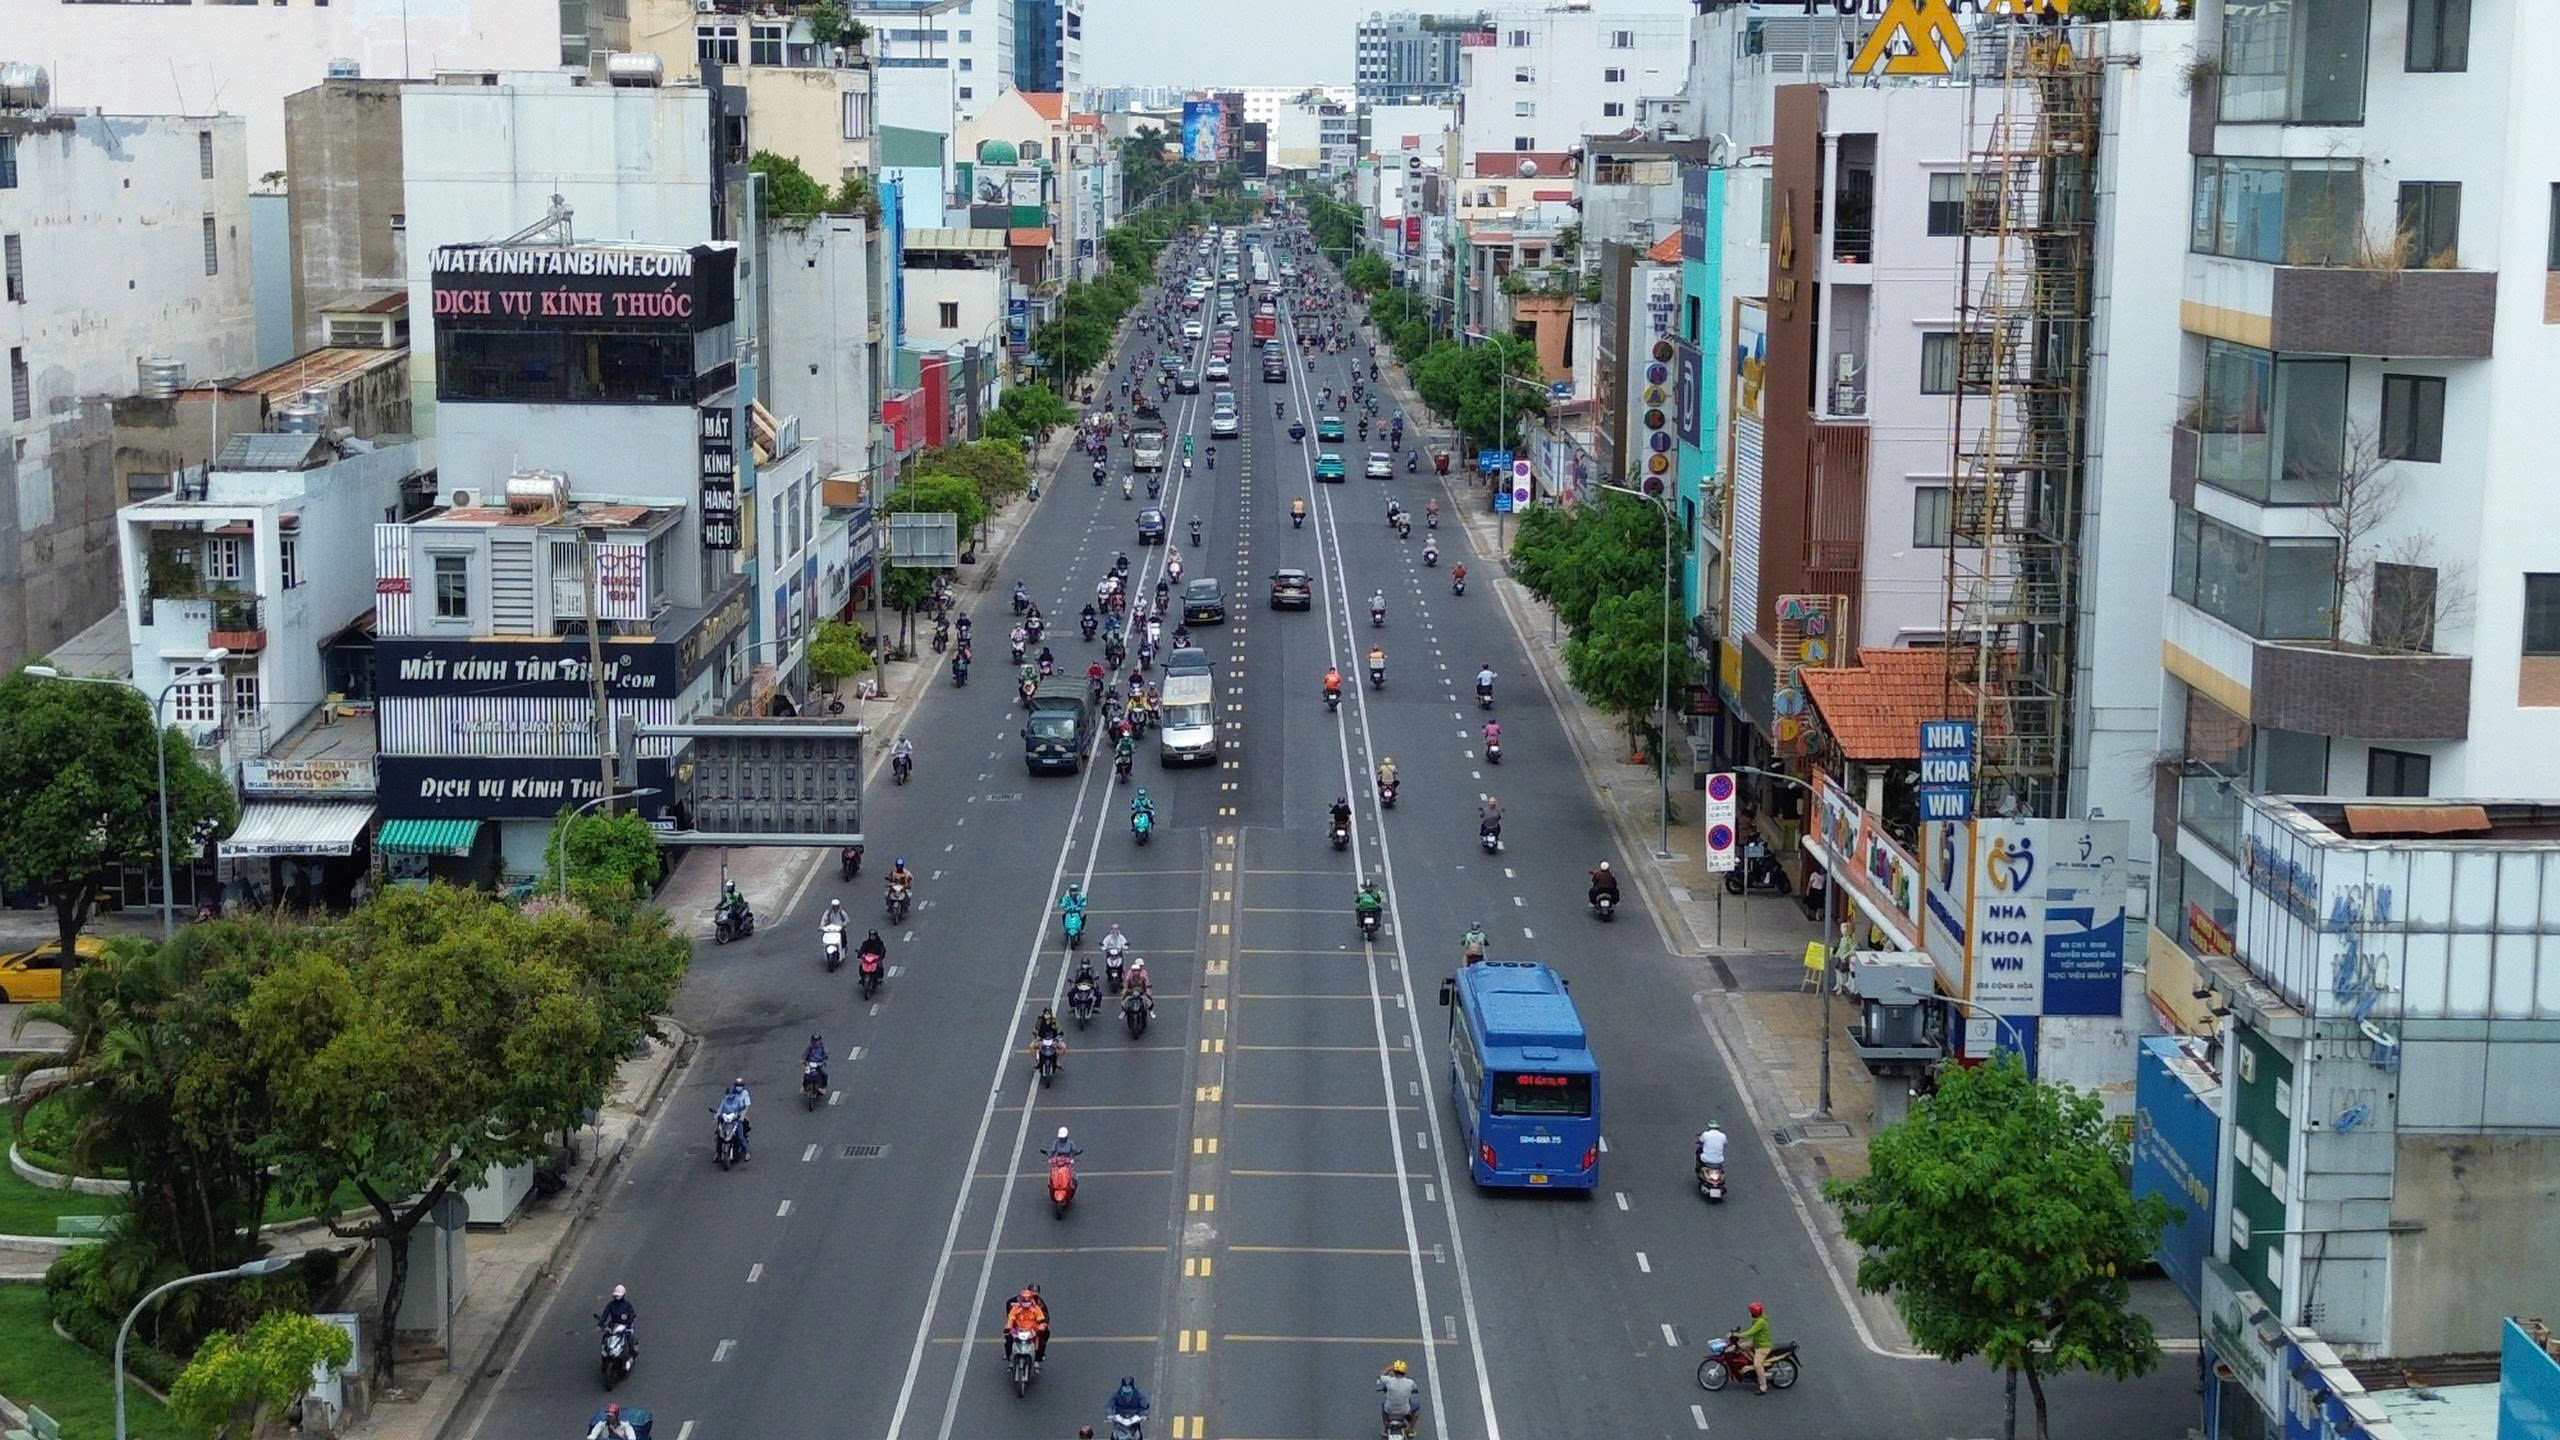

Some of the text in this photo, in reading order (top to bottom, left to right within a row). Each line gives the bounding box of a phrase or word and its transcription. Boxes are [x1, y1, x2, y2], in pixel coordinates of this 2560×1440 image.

[430, 250, 693, 278] MATKINHTANBINH.COM
[434, 282, 692, 320] DỊCH VỤ KÍNH THUỐC
[704, 450, 731, 473] KÍNH
[704, 486, 732, 510] HÀNG
[706, 524, 732, 548] HIỆU
[400, 651, 447, 681] MẮT
[453, 655, 507, 681] KÍNH
[515, 656, 557, 681] TÂN
[1927, 726, 1966, 748] NHA
[267, 769, 350, 781] PHOTOCOPY
[1922, 761, 1970, 782] KHOA
[420, 777, 471, 803] DỊCH
[478, 778, 505, 802] VỤ
[511, 776, 564, 799] KÍNH
[1927, 794, 1964, 816] WIN
[1989, 905, 2026, 919] NHA
[1981, 931, 2032, 945] KHOA
[1991, 956, 2023, 971] WIN
